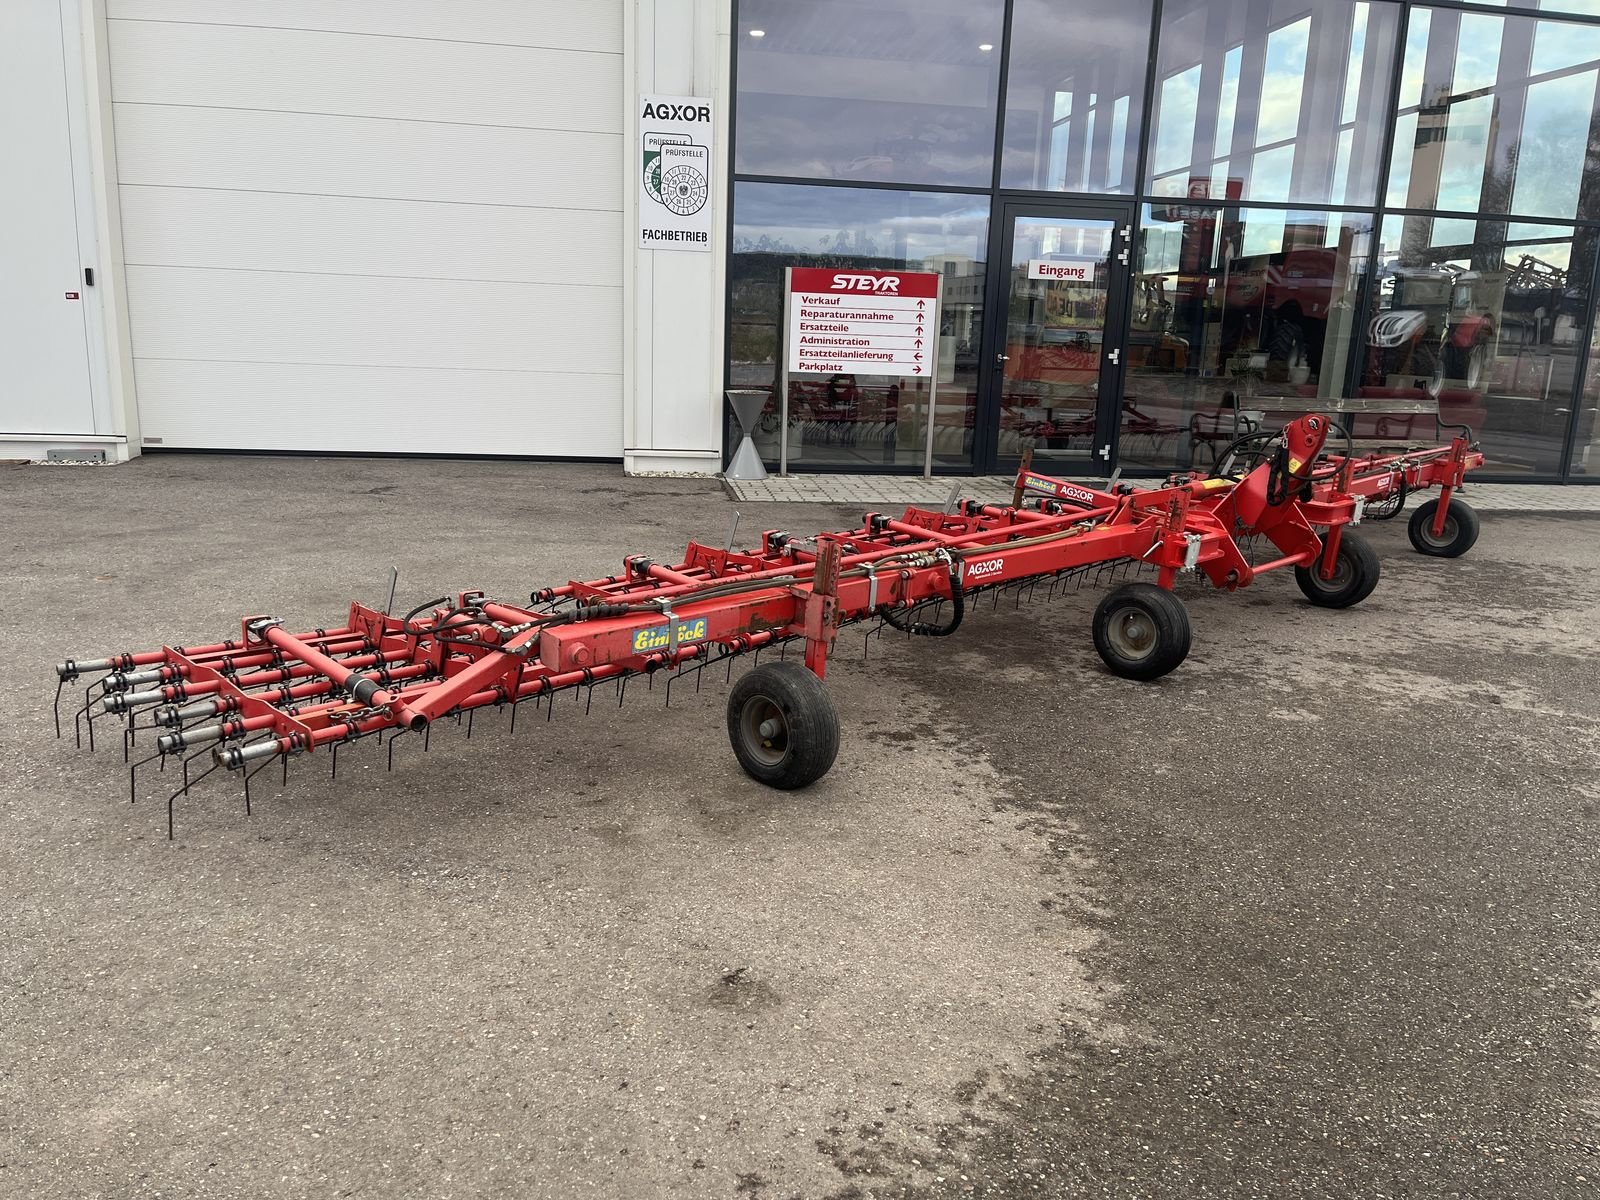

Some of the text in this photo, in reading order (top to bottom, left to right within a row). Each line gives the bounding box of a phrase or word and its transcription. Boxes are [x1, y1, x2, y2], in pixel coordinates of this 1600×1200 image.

[642, 103, 710, 122] AGXOR
[666, 149, 703, 157] PRÜFSTELLE
[643, 229, 708, 242] FACHBETRIEB
[1039, 265, 1085, 279] Eingang
[830, 274, 900, 291] STEYR
[801, 296, 840, 305] Verkauf
[800, 310, 894, 320] Reparaturannahme
[800, 323, 849, 332] Ersatzteile
[800, 336, 870, 346] Administration
[799, 349, 894, 361] Ersatzteilanlieferung
[799, 363, 843, 372] Parkplatz
[1060, 486, 1094, 502] AGXOR
[967, 559, 1004, 577] AGXOR
